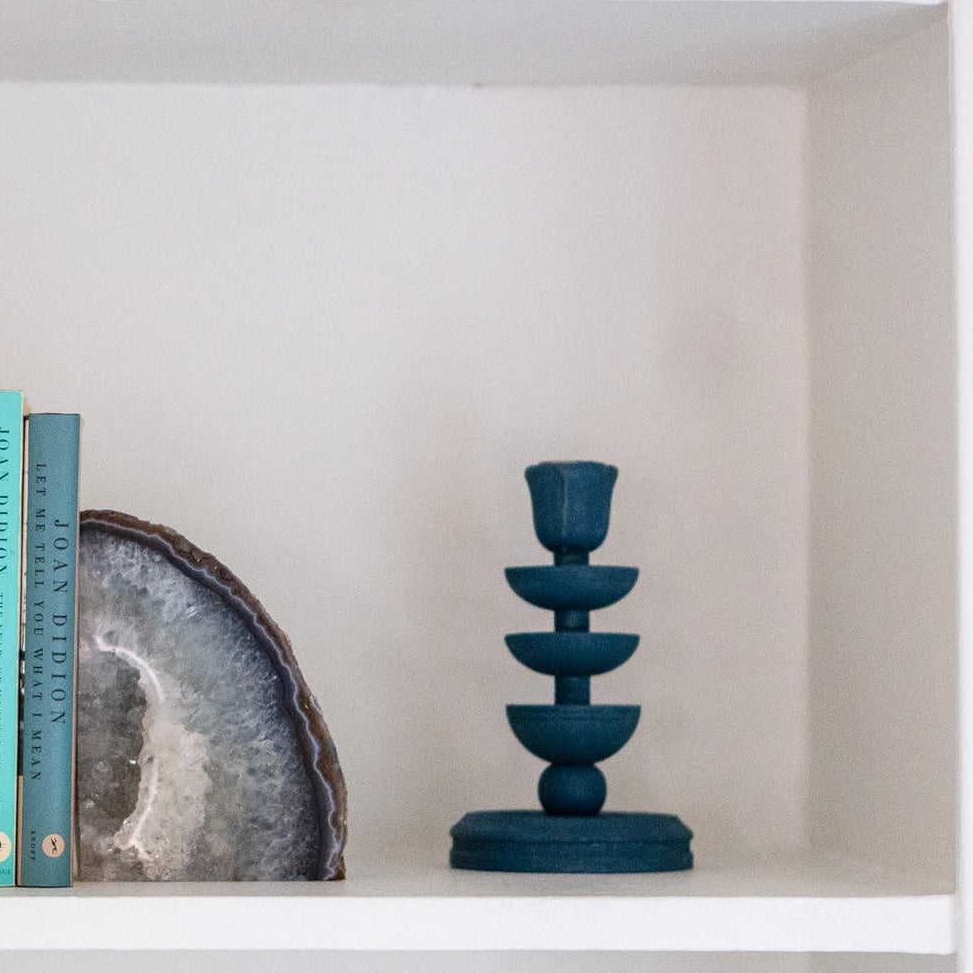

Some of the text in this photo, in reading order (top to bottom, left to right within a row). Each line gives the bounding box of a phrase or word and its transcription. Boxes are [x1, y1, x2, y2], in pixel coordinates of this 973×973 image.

[36, 463, 47, 497] LET
[35, 508, 46, 532] ME
[34, 543, 45, 589] TELL
[33, 600, 44, 636] YOU
[51, 519, 70, 725] JOAN DIDION
[32, 647, 43, 700] WHAT
[31, 729, 42, 781] MEAN
